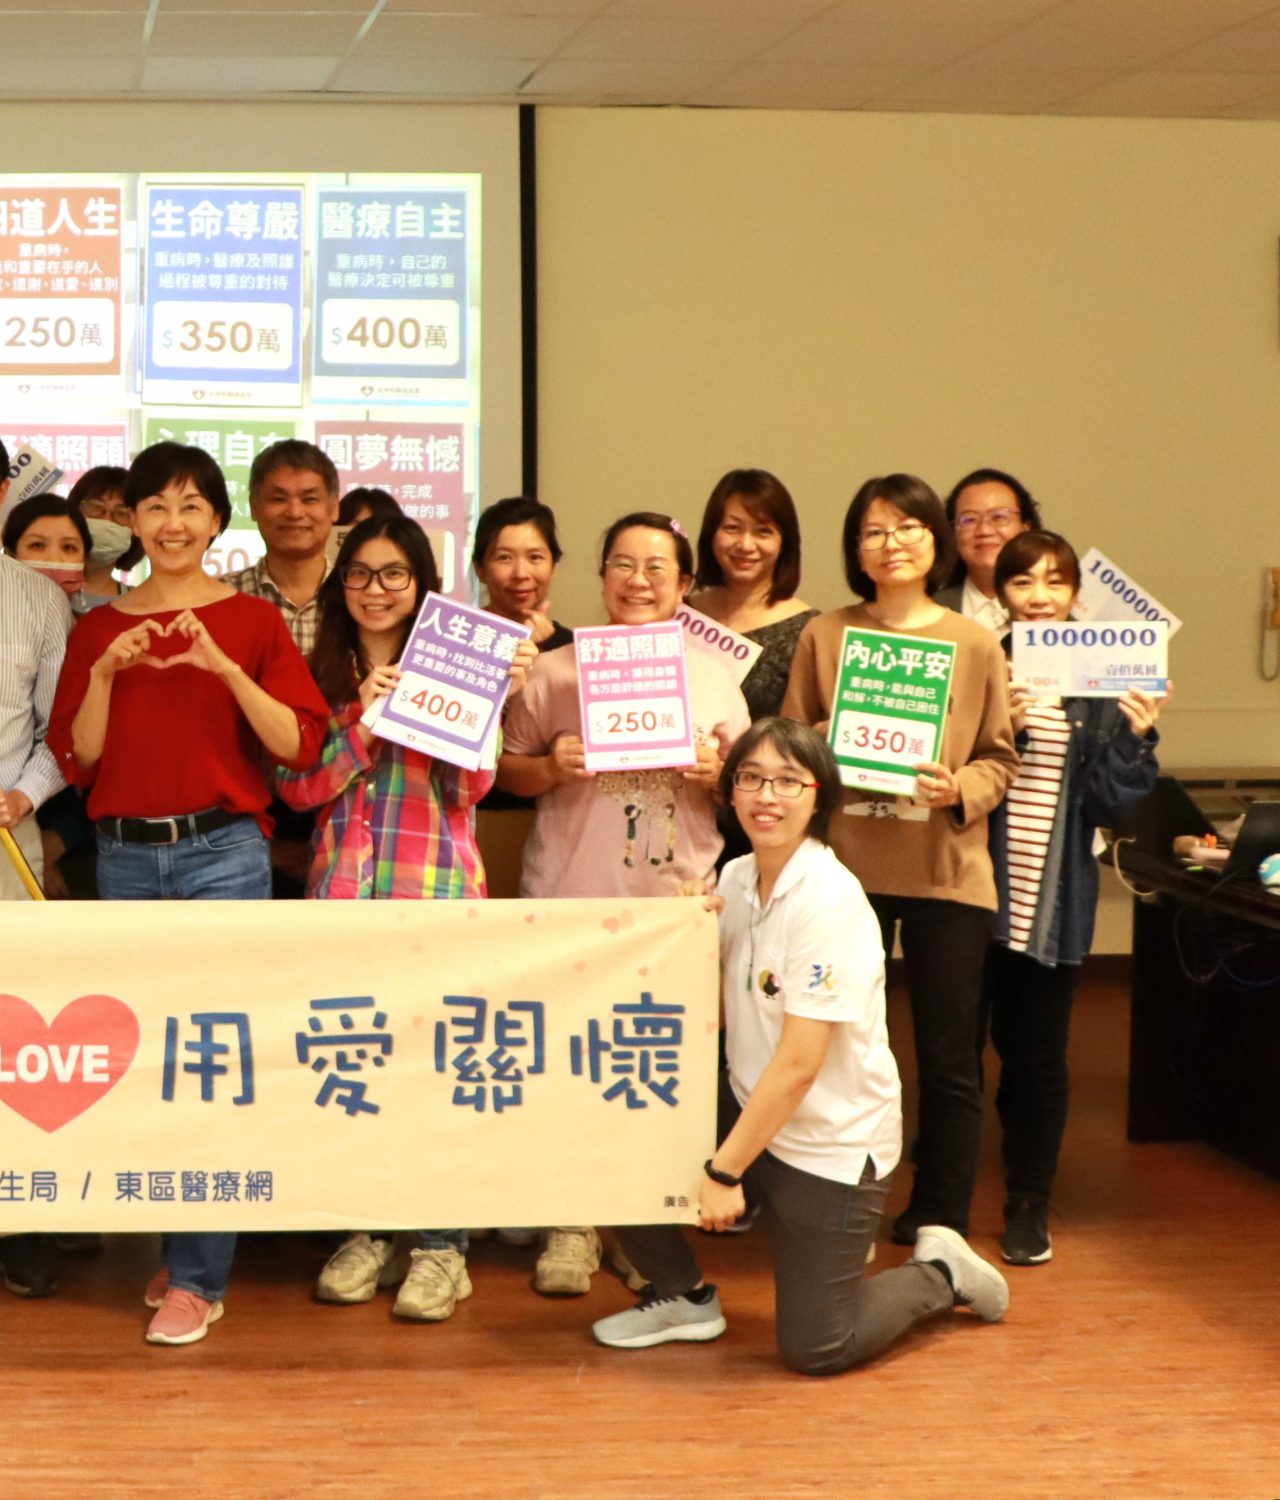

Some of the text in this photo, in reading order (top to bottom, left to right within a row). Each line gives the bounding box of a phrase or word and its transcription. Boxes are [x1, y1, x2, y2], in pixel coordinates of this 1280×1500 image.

[151, 199, 300, 242] 生命尊嚴
[322, 200, 464, 240] 醫療自主
[320, 433, 460, 473] 圓夢無憾
[418, 607, 520, 662] 人生意義
[579, 632, 682, 664] 舒適照顧
[1025, 628, 1157, 648] 1000000
[845, 640, 952, 681] 內心平安
[160, 991, 687, 1116] 用愛關懷
[113, 1169, 275, 1203] 東區醫療網
[664, 1195, 689, 1207] 廣告
